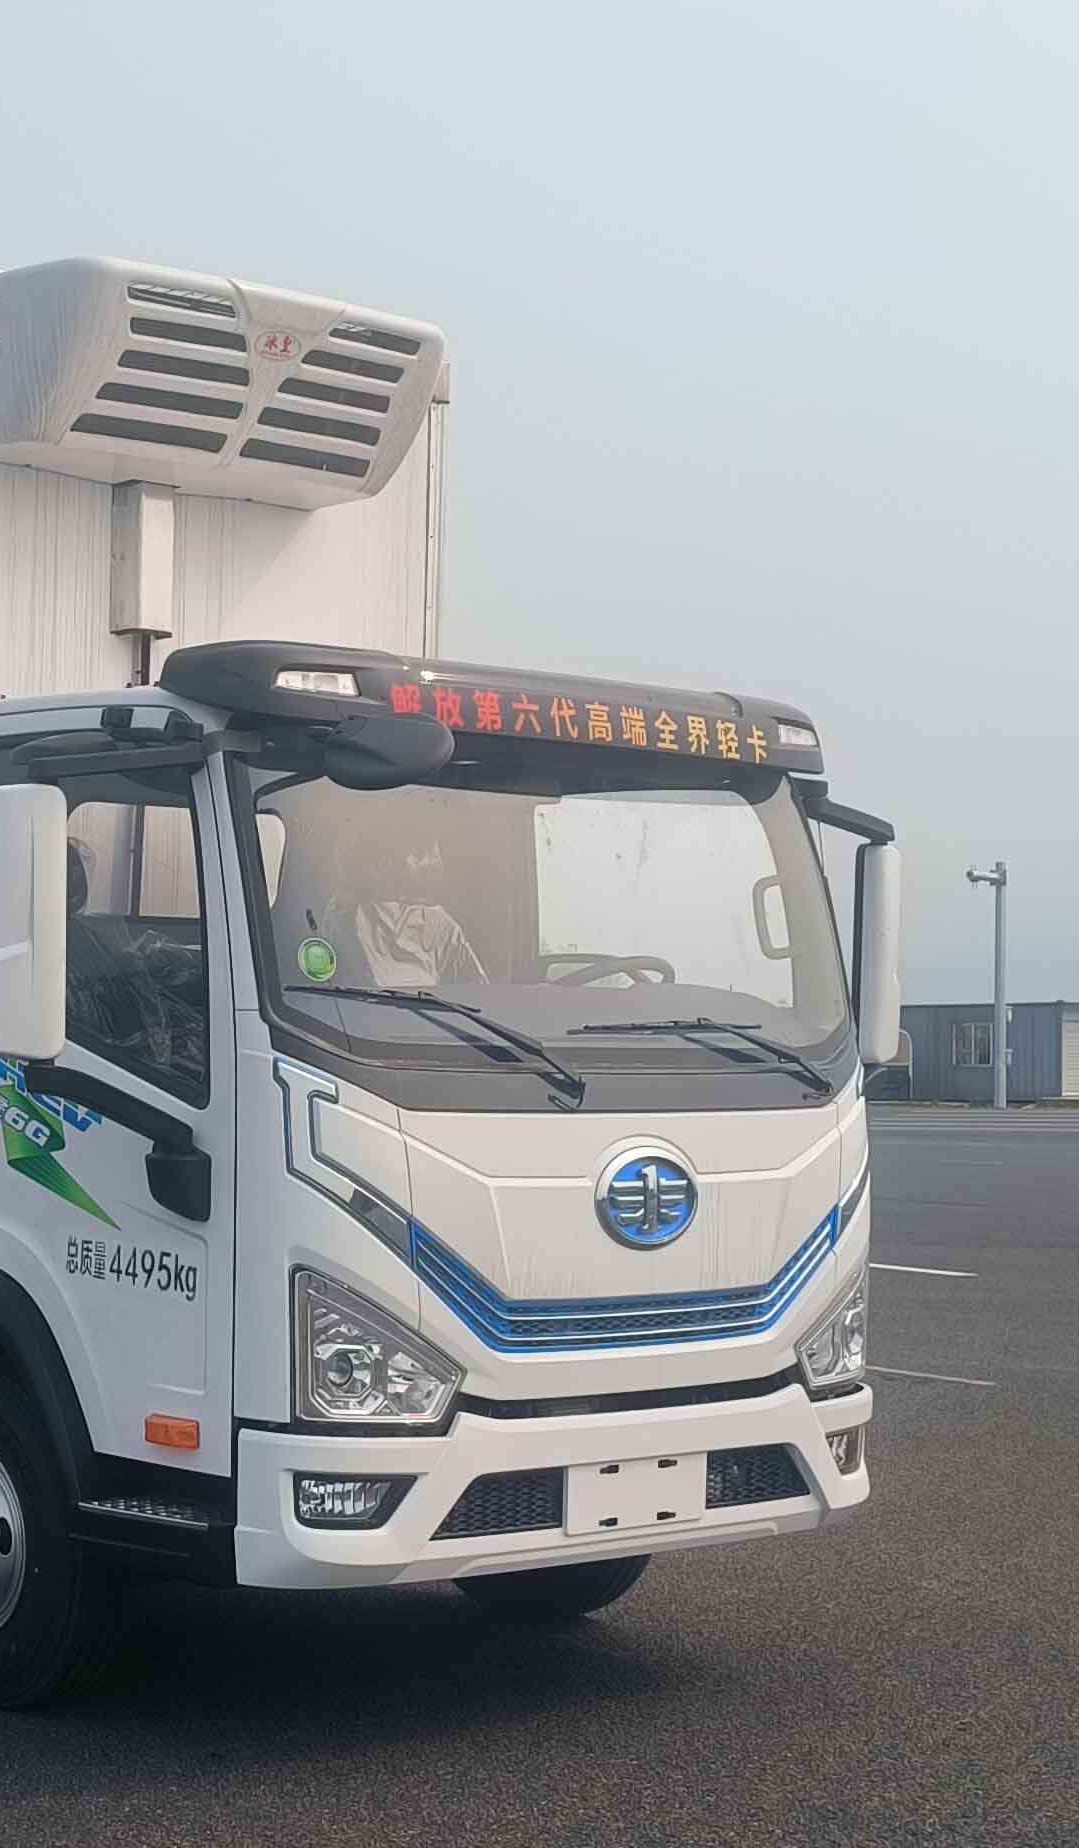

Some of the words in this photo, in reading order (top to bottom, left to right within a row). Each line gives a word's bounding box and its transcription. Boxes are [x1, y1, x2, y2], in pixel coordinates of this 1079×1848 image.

[392, 685, 767, 764] 解放第六代高端全界轻卡
[66, 1236, 197, 1301] 总质量4495kg
